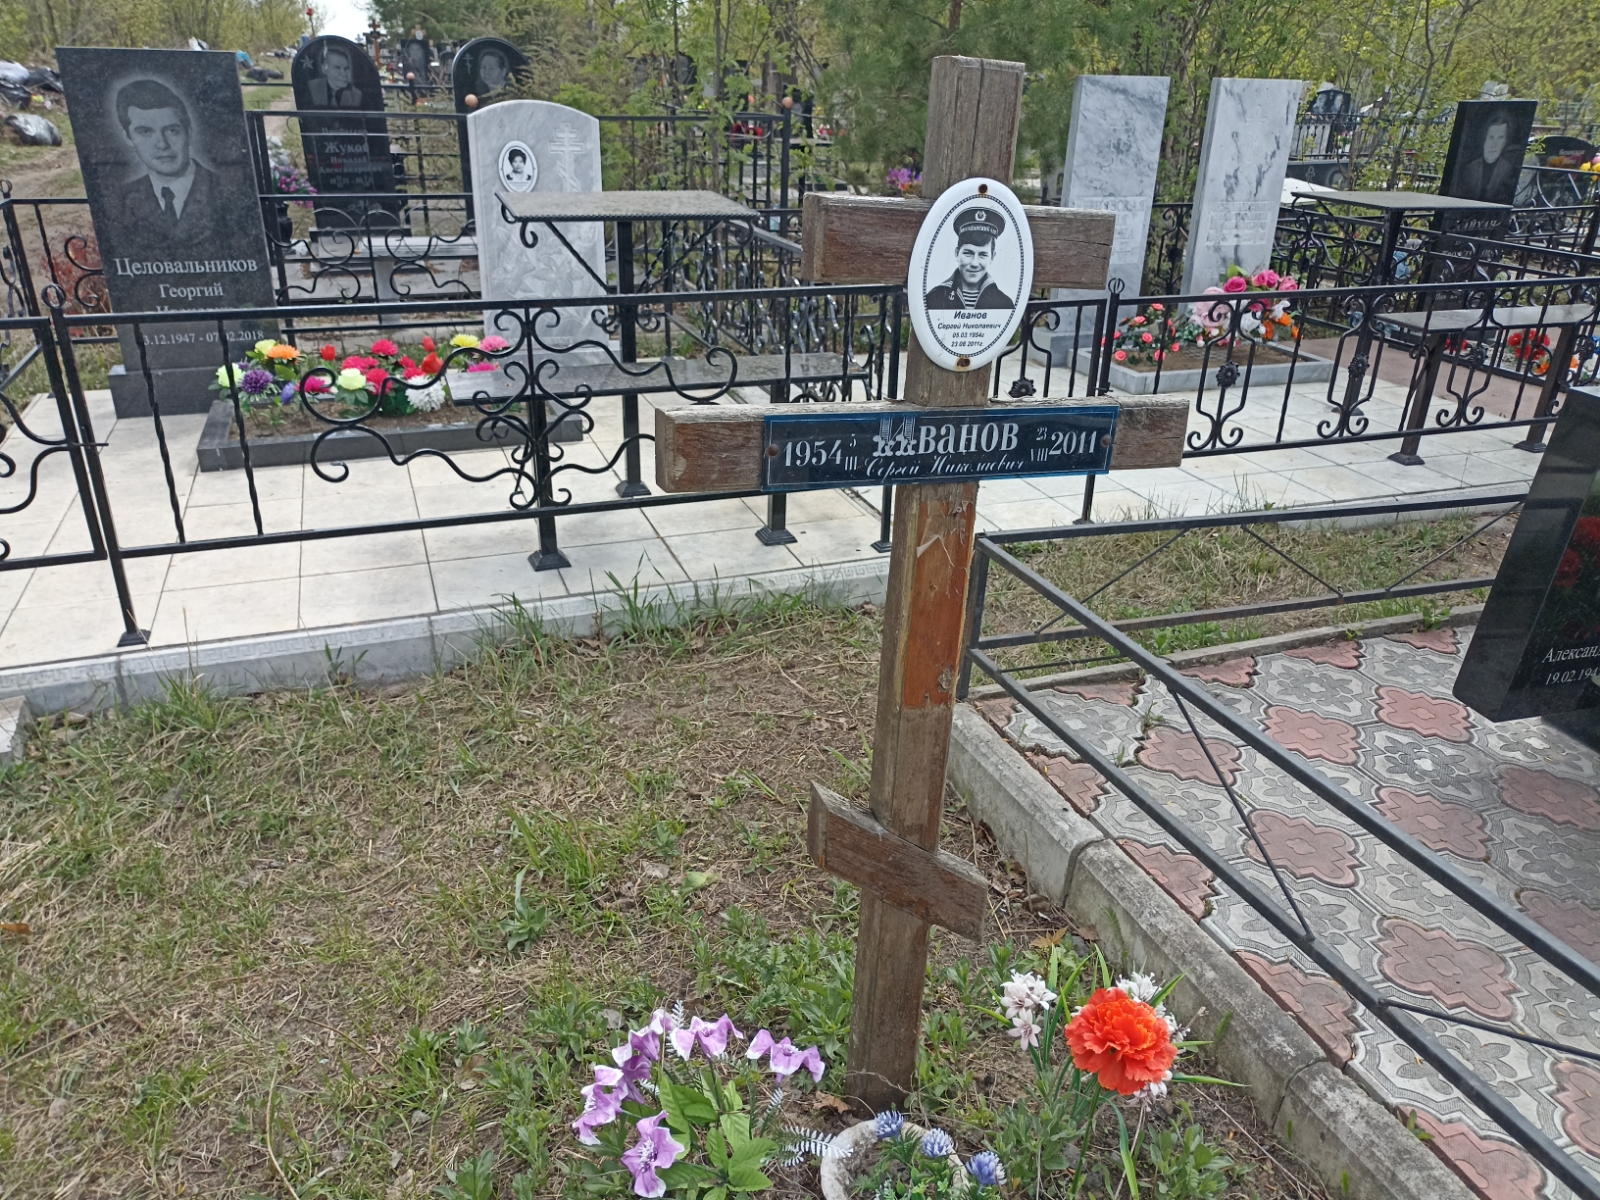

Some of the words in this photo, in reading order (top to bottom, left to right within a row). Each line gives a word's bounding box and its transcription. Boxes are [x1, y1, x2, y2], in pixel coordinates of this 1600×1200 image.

[324, 142, 369, 155] Жуков
[113, 258, 258, 277] Целовальников
[159, 282, 224, 300] Георгий
[953, 310, 988, 320] Иванов
[937, 322, 962, 331] Сергей
[962, 322, 1002, 330] Николаевич
[142, 333, 195, 346] 3.12.1947
[1035, 426, 1049, 441] 23
[1049, 430, 1098, 455] 2011
[783, 439, 842, 467] 1954
[1545, 666, 1600, 685] 19.02.194
